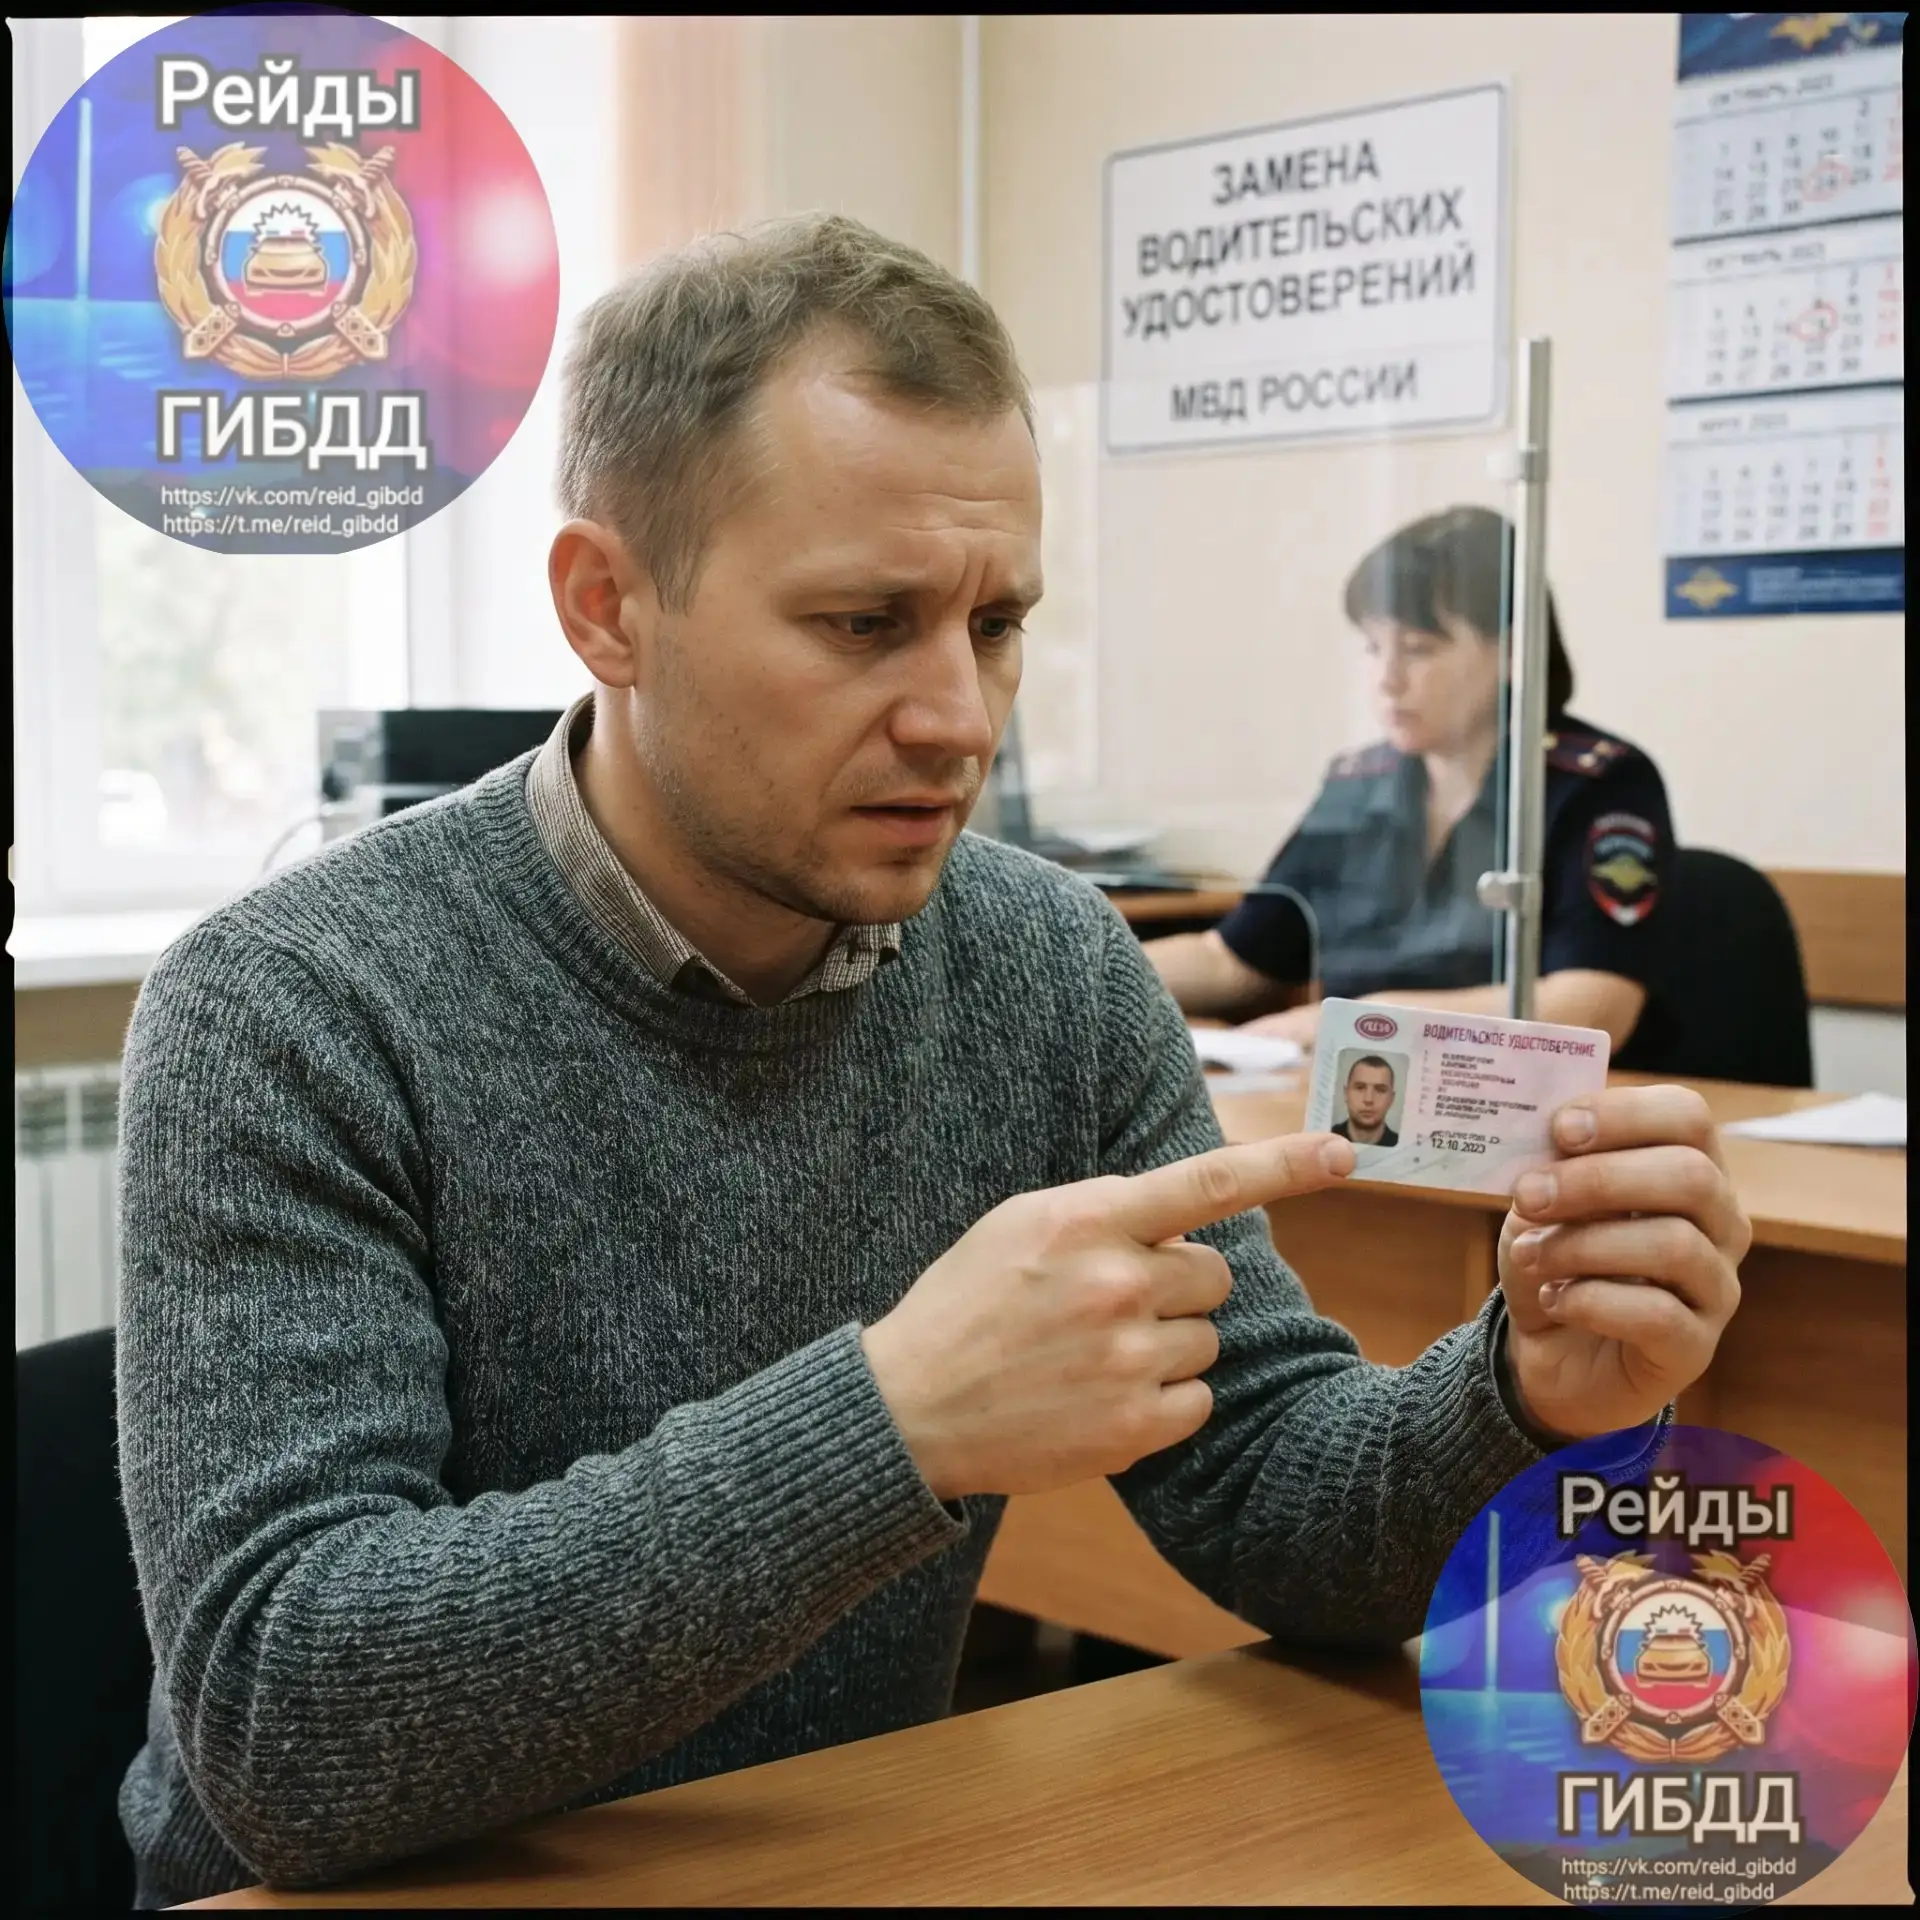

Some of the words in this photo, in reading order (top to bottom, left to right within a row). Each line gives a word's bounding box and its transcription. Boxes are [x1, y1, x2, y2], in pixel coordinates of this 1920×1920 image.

[1212, 140, 1380, 207] ЗАМЕНА
[1137, 187, 1465, 280] ВОДИТЕЛЬСКИХ
[1122, 240, 1477, 340] УДОСТОВЕРЕНИЙ
[1169, 379, 1249, 424] МВД
[1257, 359, 1419, 416] РОССИИ
[1423, 1023, 1505, 1047] ВОДИТЕЛЬСКОЕ
